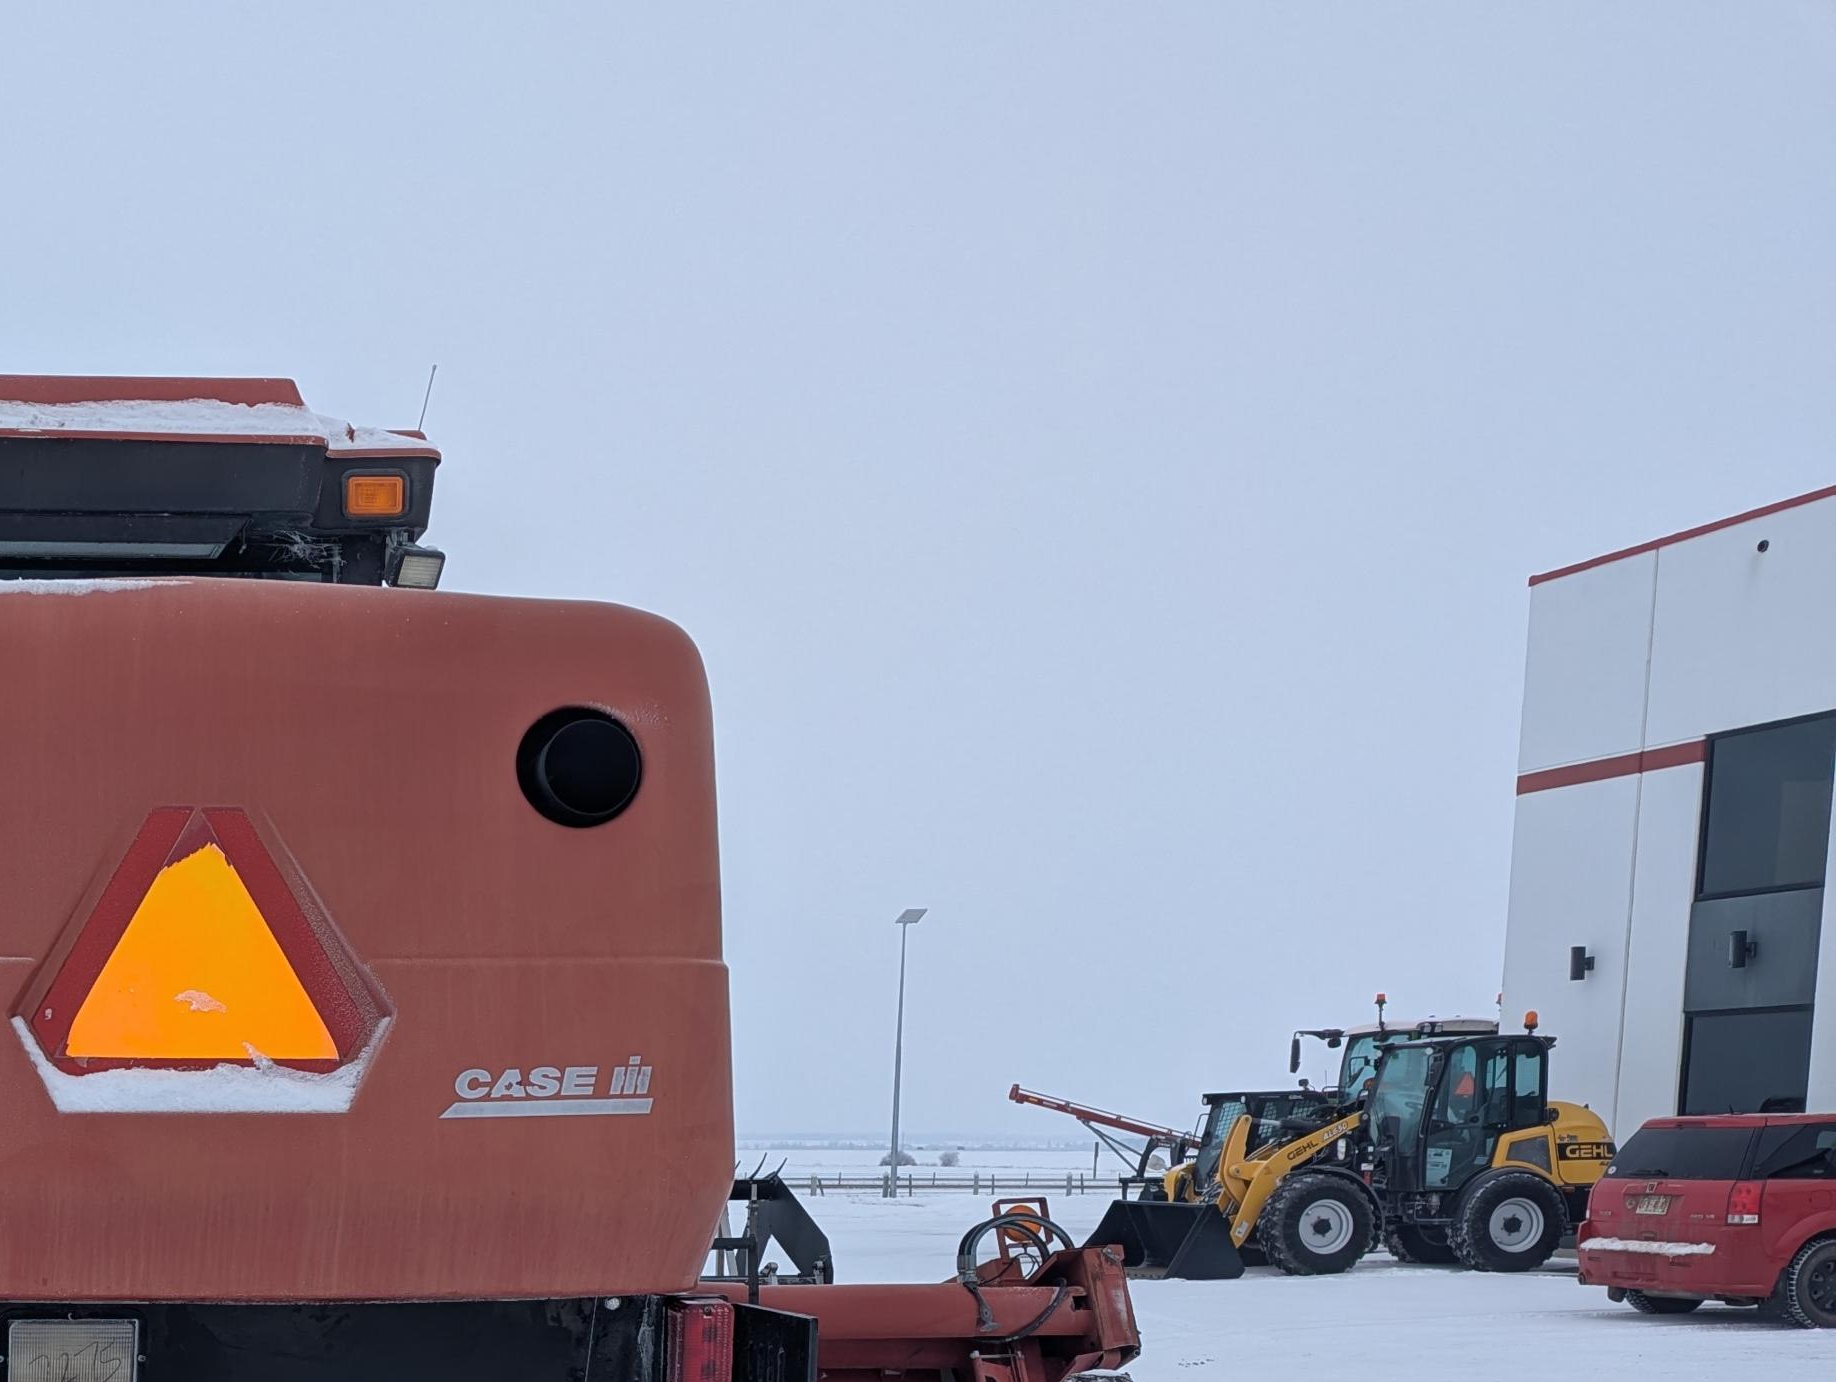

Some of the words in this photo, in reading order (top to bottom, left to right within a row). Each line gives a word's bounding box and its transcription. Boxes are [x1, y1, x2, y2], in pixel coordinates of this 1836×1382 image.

[454, 1065, 598, 1100] CASE
[1287, 1140, 1318, 1160] GEHL
[1565, 1144, 1614, 1158] GEHL
